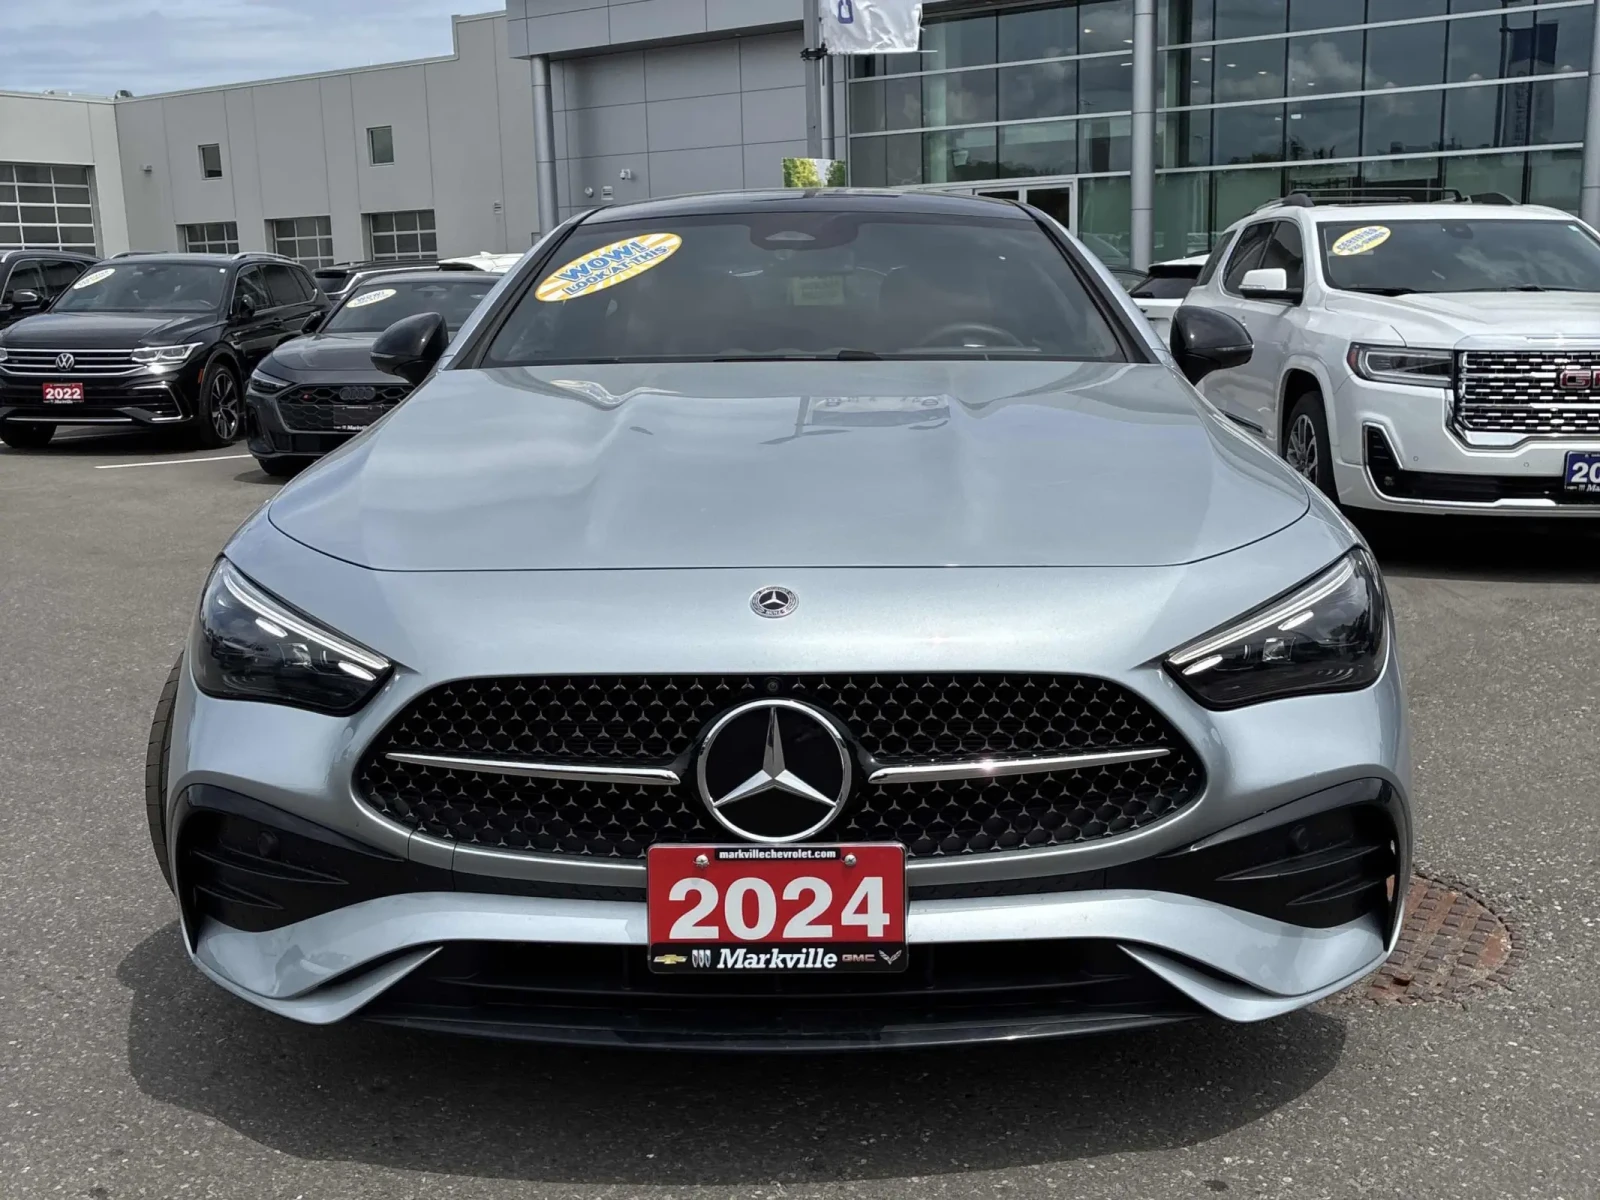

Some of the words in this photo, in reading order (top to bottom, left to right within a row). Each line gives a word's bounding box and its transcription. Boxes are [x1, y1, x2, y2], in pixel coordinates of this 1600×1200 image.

[558, 241, 649, 282] WOW!
[564, 271, 608, 294] LOOK
[609, 261, 631, 276] AT
[631, 245, 669, 266] THIS
[45, 388, 82, 399] 2022
[719, 849, 837, 859] markvillechevrolet.com
[668, 876, 890, 940] 2024
[717, 948, 838, 969] Markville
[841, 953, 877, 962] GMC
